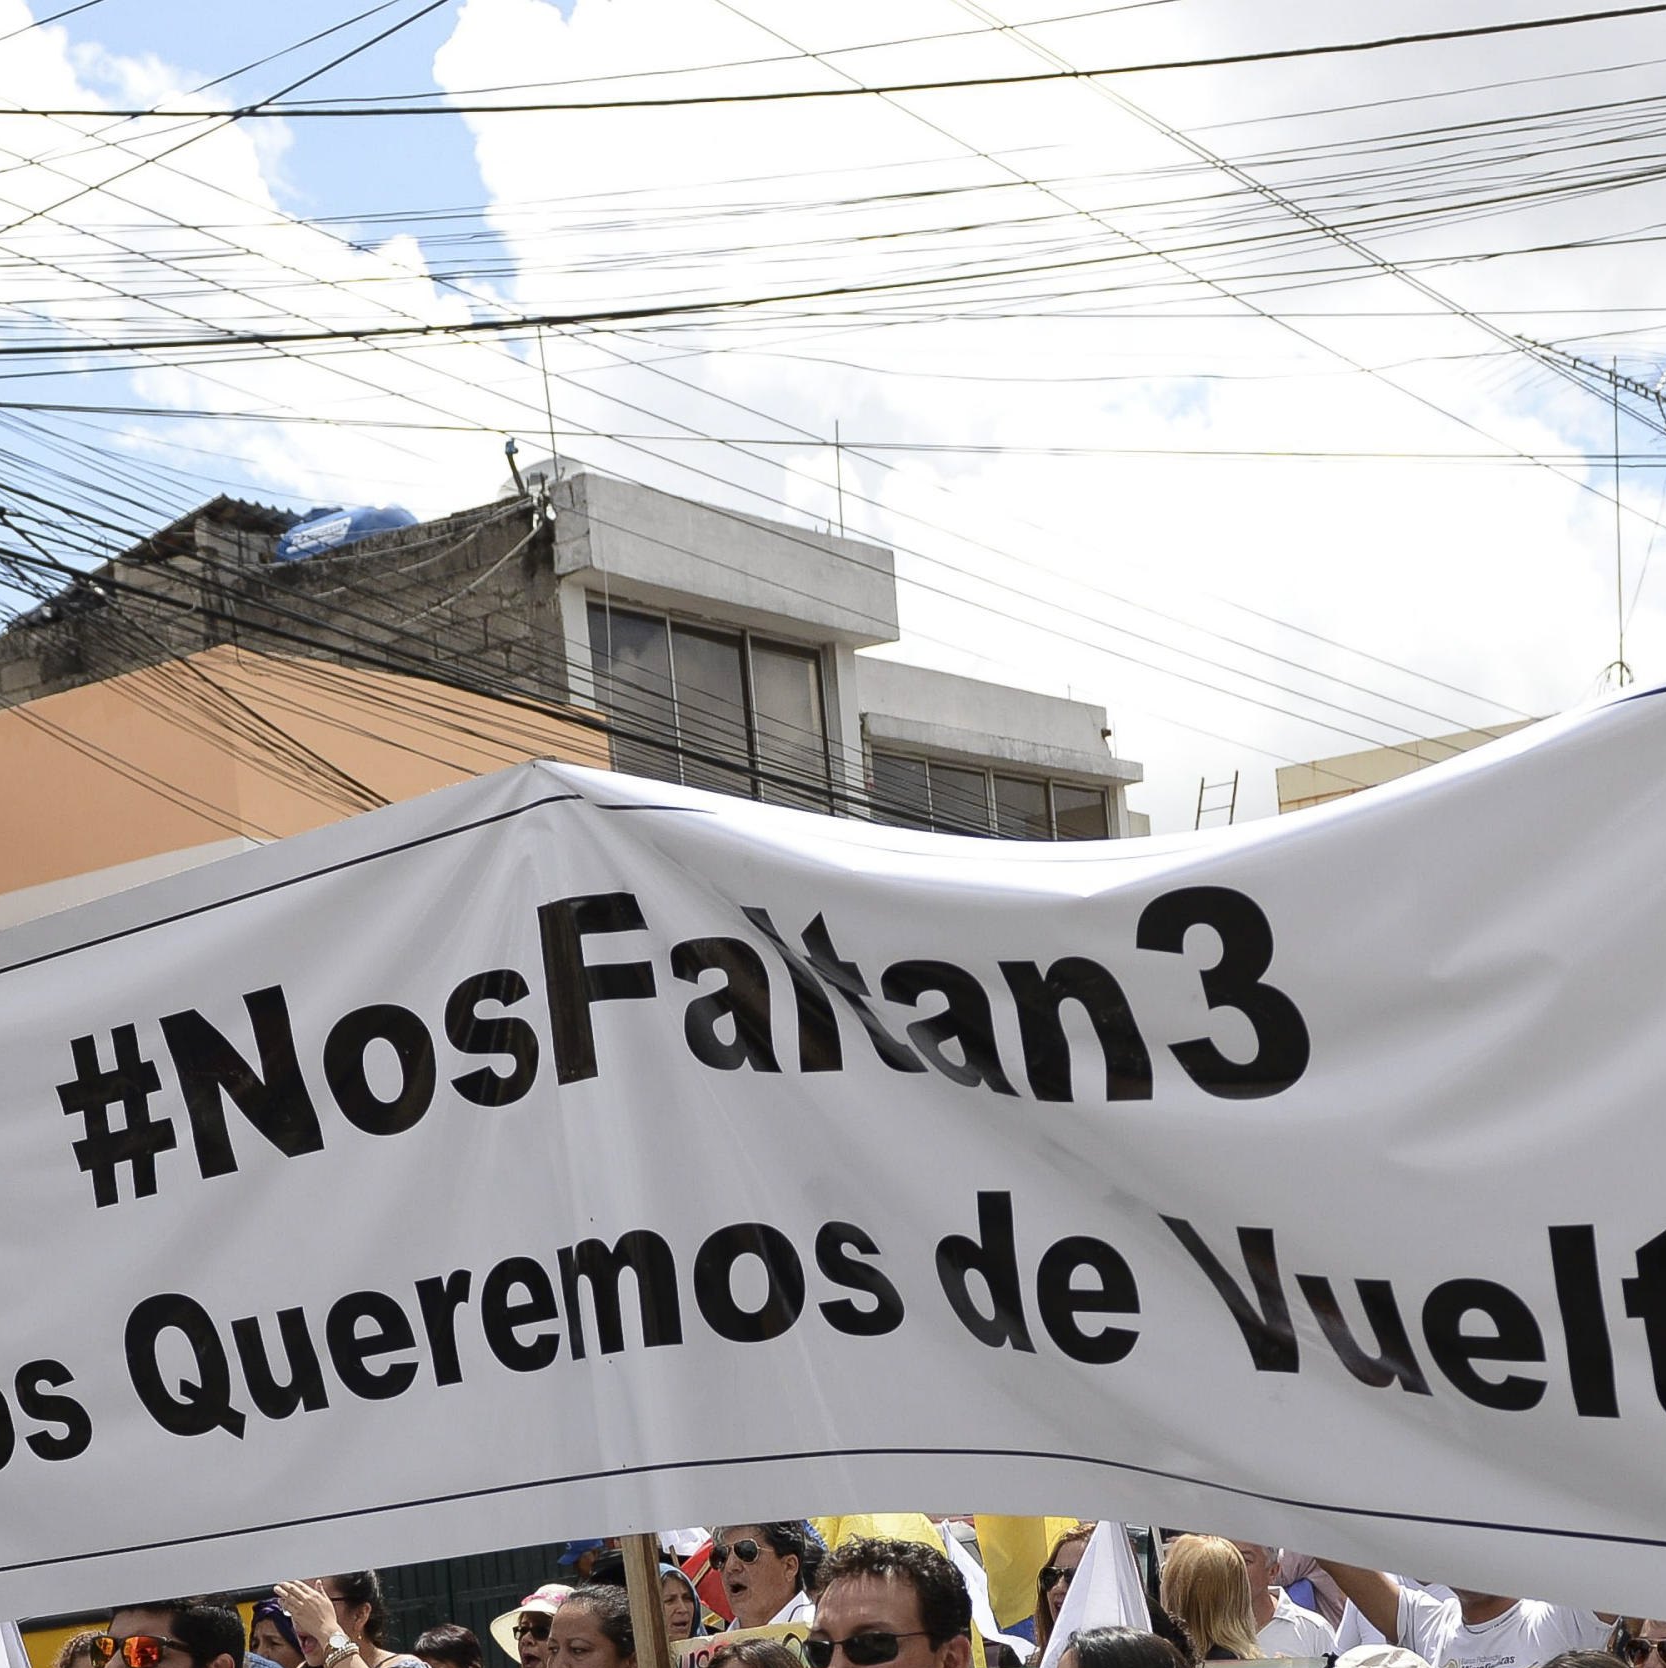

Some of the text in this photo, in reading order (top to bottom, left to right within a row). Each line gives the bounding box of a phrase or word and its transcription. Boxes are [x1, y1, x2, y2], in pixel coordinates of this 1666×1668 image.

[56, 884, 1310, 1208] #NosFaltan3
[123, 1217, 904, 1443] Queremos
[932, 1190, 1141, 1368] de
